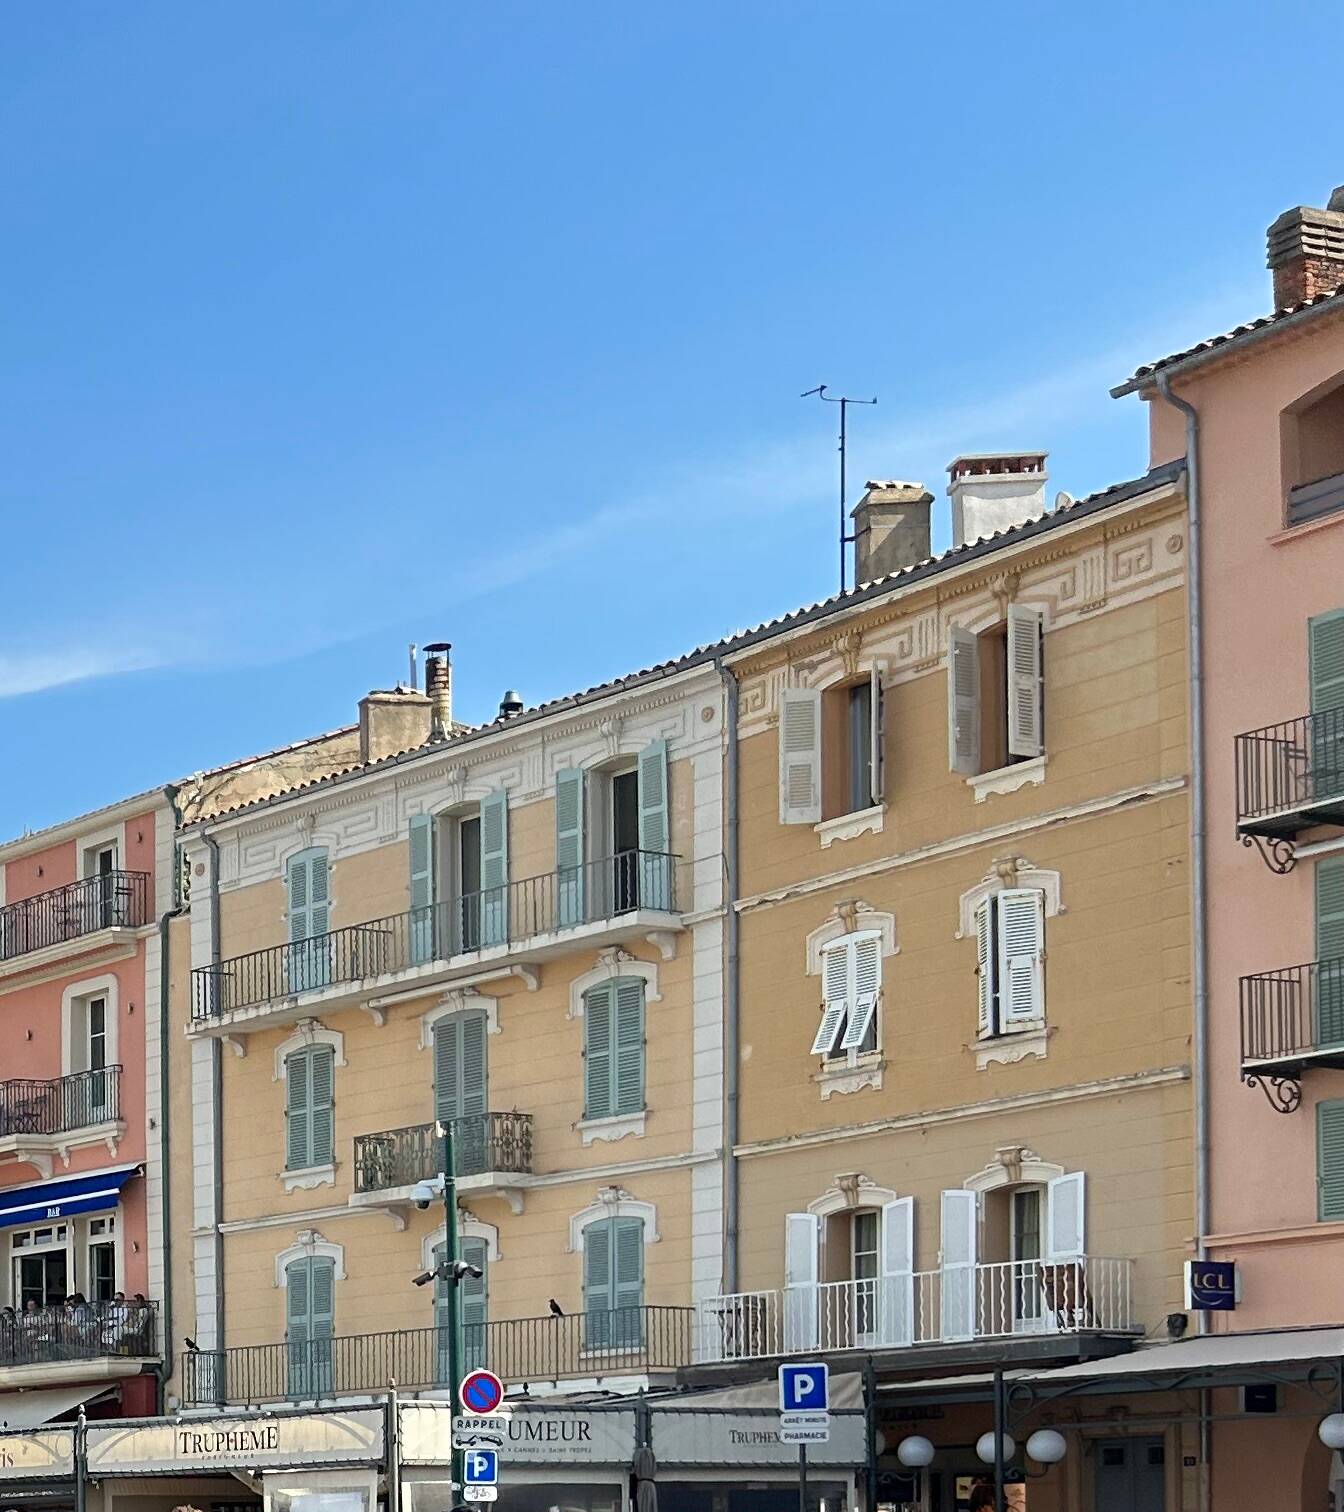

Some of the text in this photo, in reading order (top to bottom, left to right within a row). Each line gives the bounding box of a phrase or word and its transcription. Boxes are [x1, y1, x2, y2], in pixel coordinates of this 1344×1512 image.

[1193, 1272, 1231, 1289] LCL
[793, 1373, 815, 1403] P
[457, 1419, 502, 1429] RAPPEL
[508, 1420, 593, 1441] UMEUR
[179, 1425, 279, 1455] TRUPHEME
[728, 1429, 782, 1445] TRUPHEM
[784, 1431, 827, 1440] PHARMACIE
[473, 1456, 489, 1478] P
